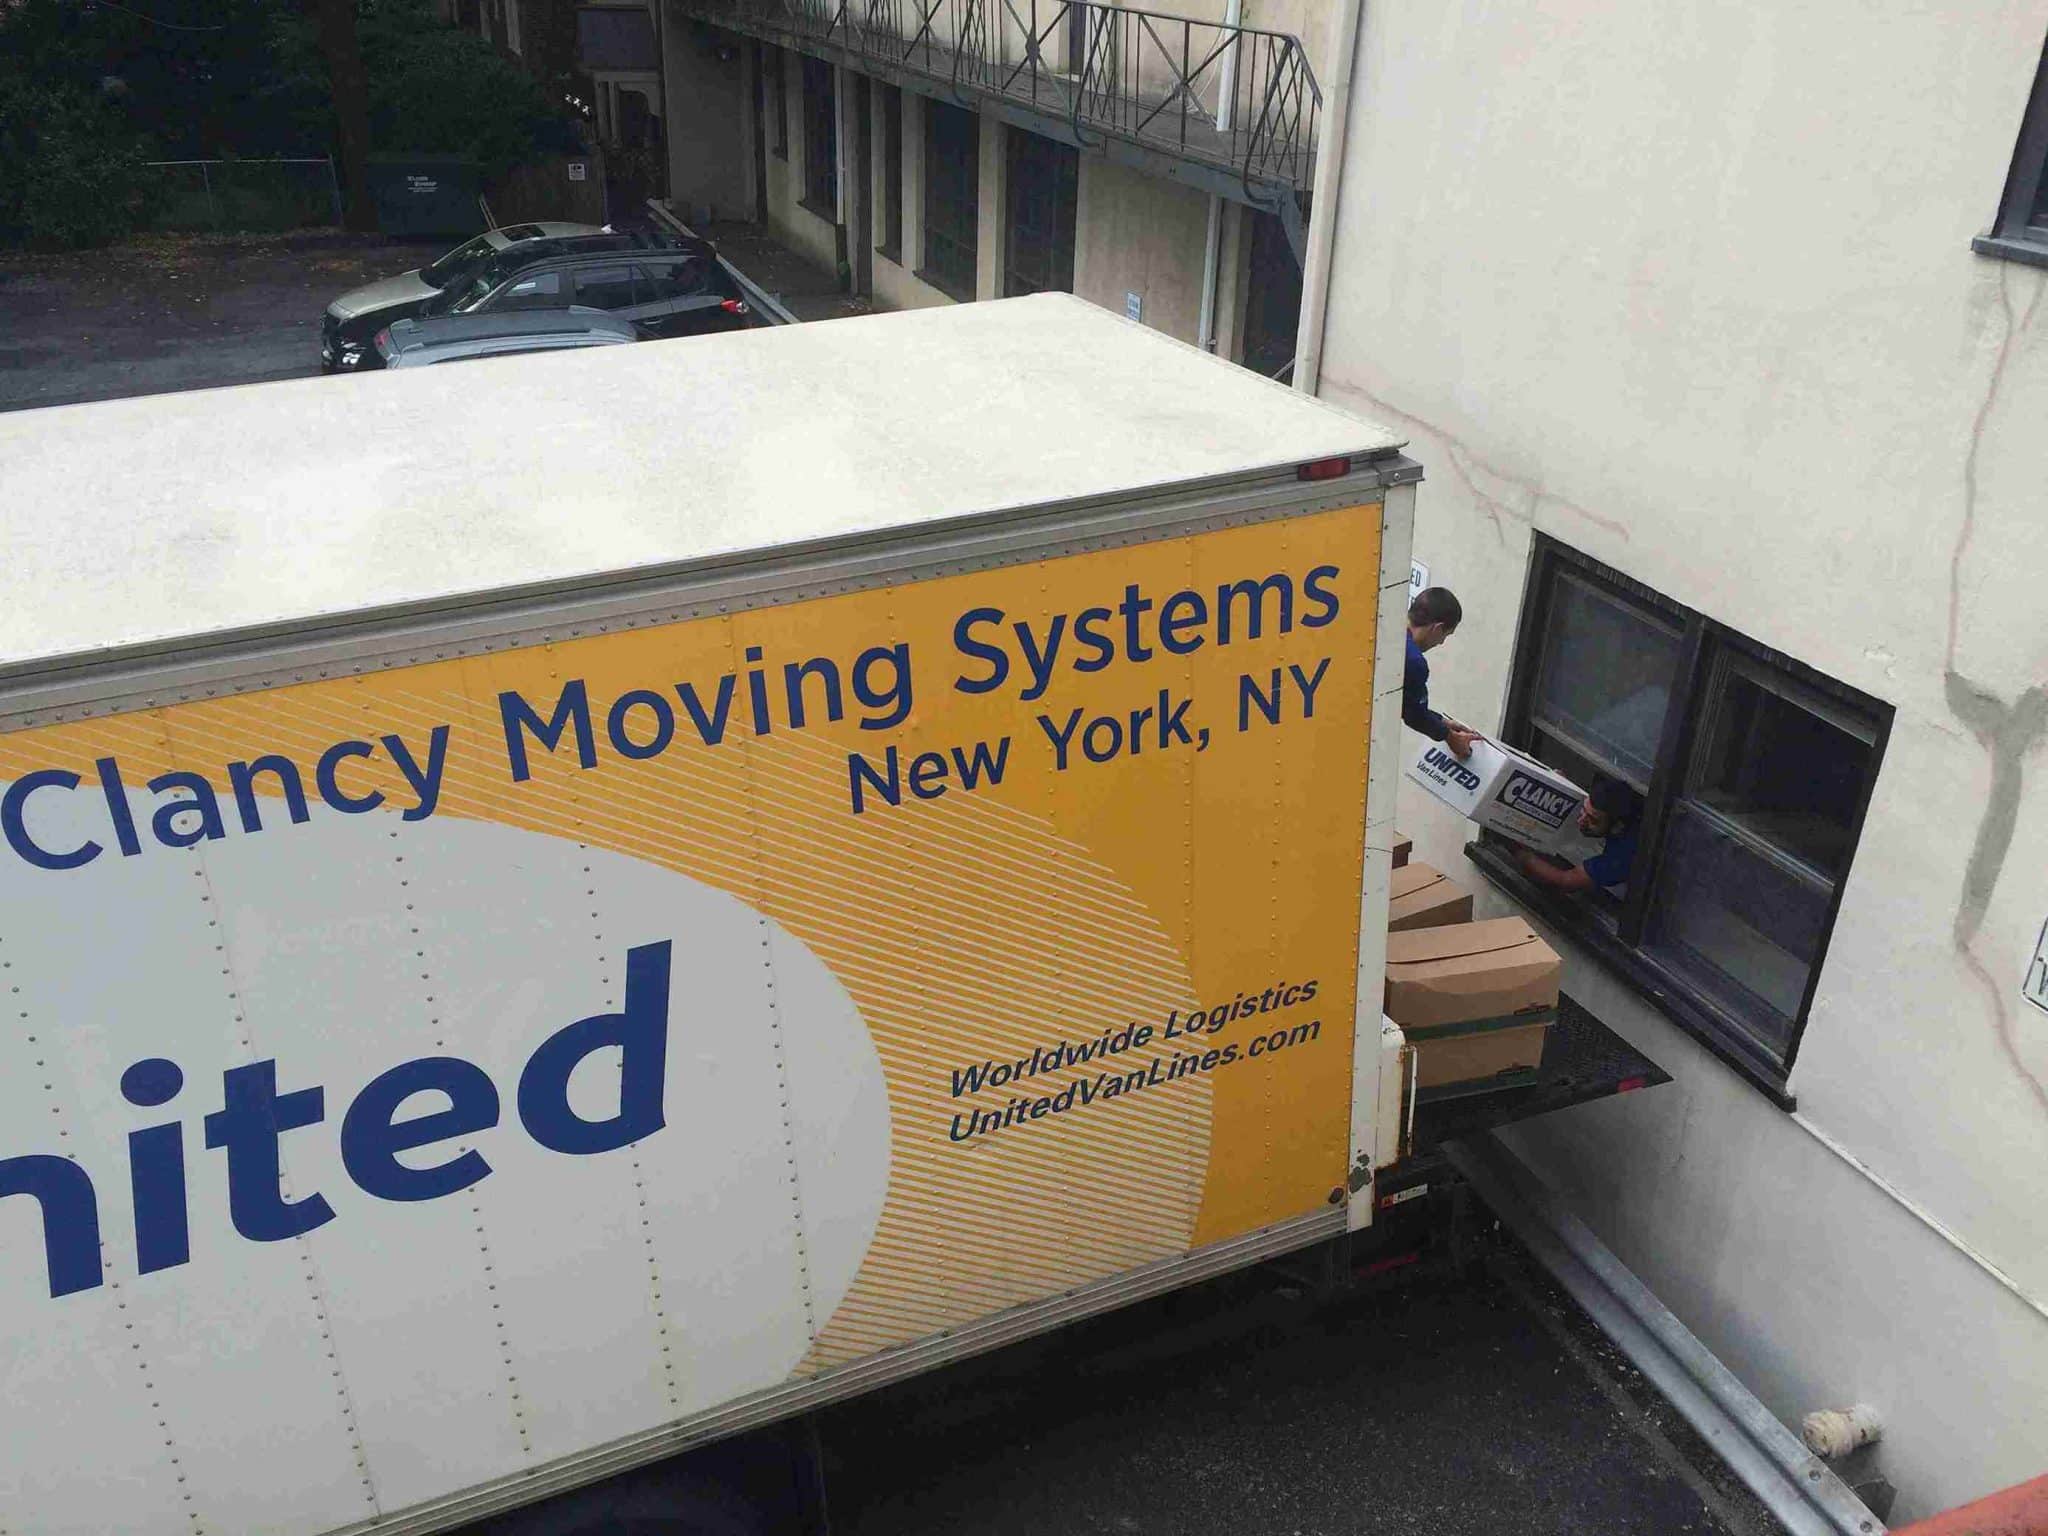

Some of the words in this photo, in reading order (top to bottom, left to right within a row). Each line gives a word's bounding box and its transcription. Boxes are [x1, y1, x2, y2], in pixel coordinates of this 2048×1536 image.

[0, 726, 448, 870] Clancy
[500, 644, 912, 783] Moving
[953, 565, 1341, 701] Systems
[848, 736, 1011, 815] New
[1037, 688, 1211, 753] York,
[1238, 657, 1333, 732] NY
[1416, 760, 1431, 775] Van
[1429, 771, 1448, 787] Lines
[1423, 747, 1481, 791] UNITED
[1503, 776, 1575, 818] CLANCY
[949, 1020, 1321, 1142] UnitedVanLines.com
[951, 1021, 1154, 1098] Worldwide
[1163, 978, 1319, 1041] Logistics
